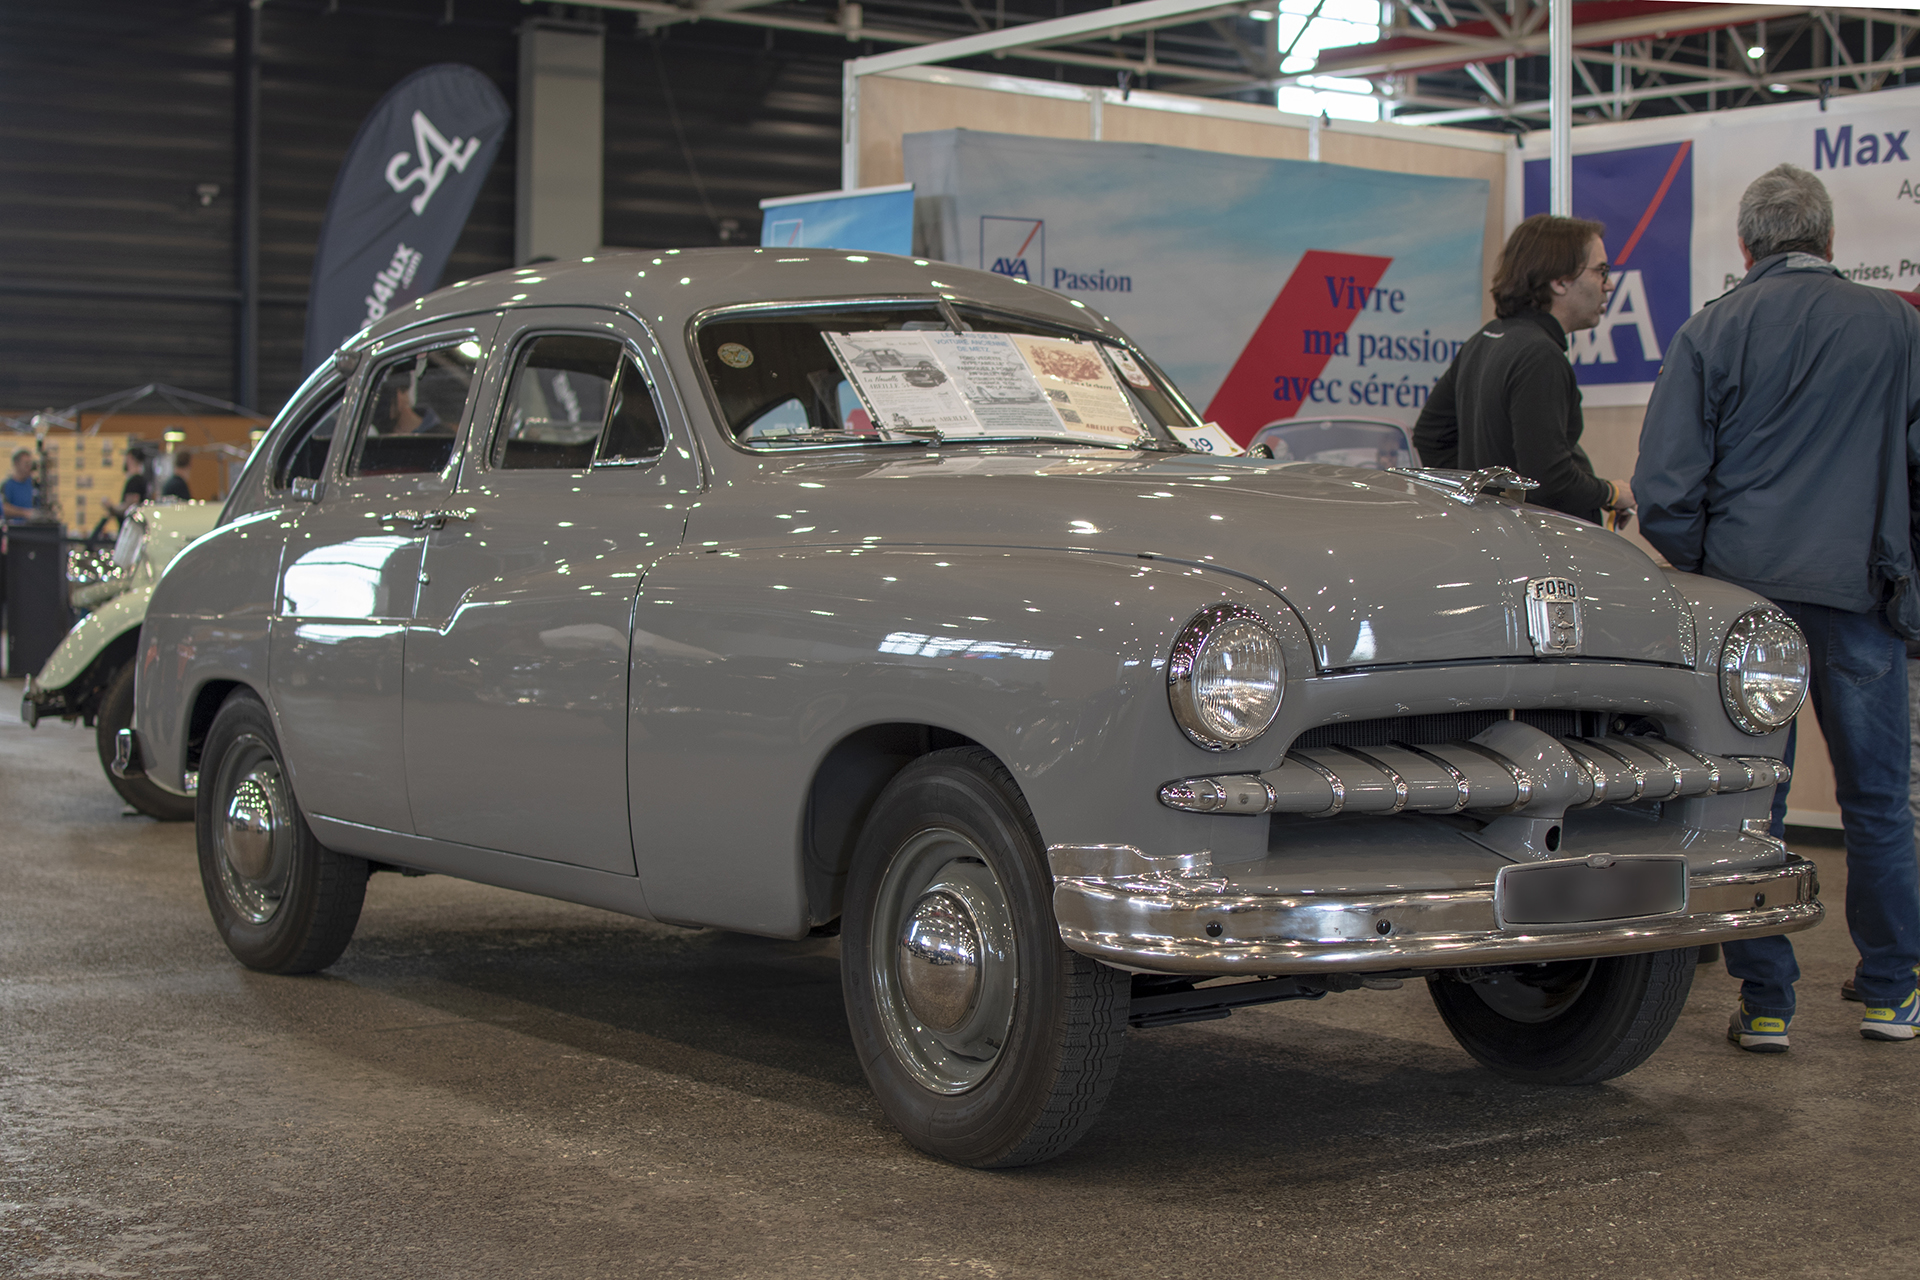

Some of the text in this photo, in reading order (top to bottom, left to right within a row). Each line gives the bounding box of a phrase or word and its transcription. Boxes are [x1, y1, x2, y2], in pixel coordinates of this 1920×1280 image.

[1814, 124, 1911, 171] Max
[1053, 267, 1132, 293] Passion
[1899, 259, 1920, 277] Pr
[361, 243, 414, 329] d4lux
[1324, 276, 1406, 314] Vivre
[1302, 329, 1349, 358] ma
[1273, 375, 1342, 404] avec
[1189, 437, 1214, 452] 89
[1535, 580, 1576, 598] FORD
